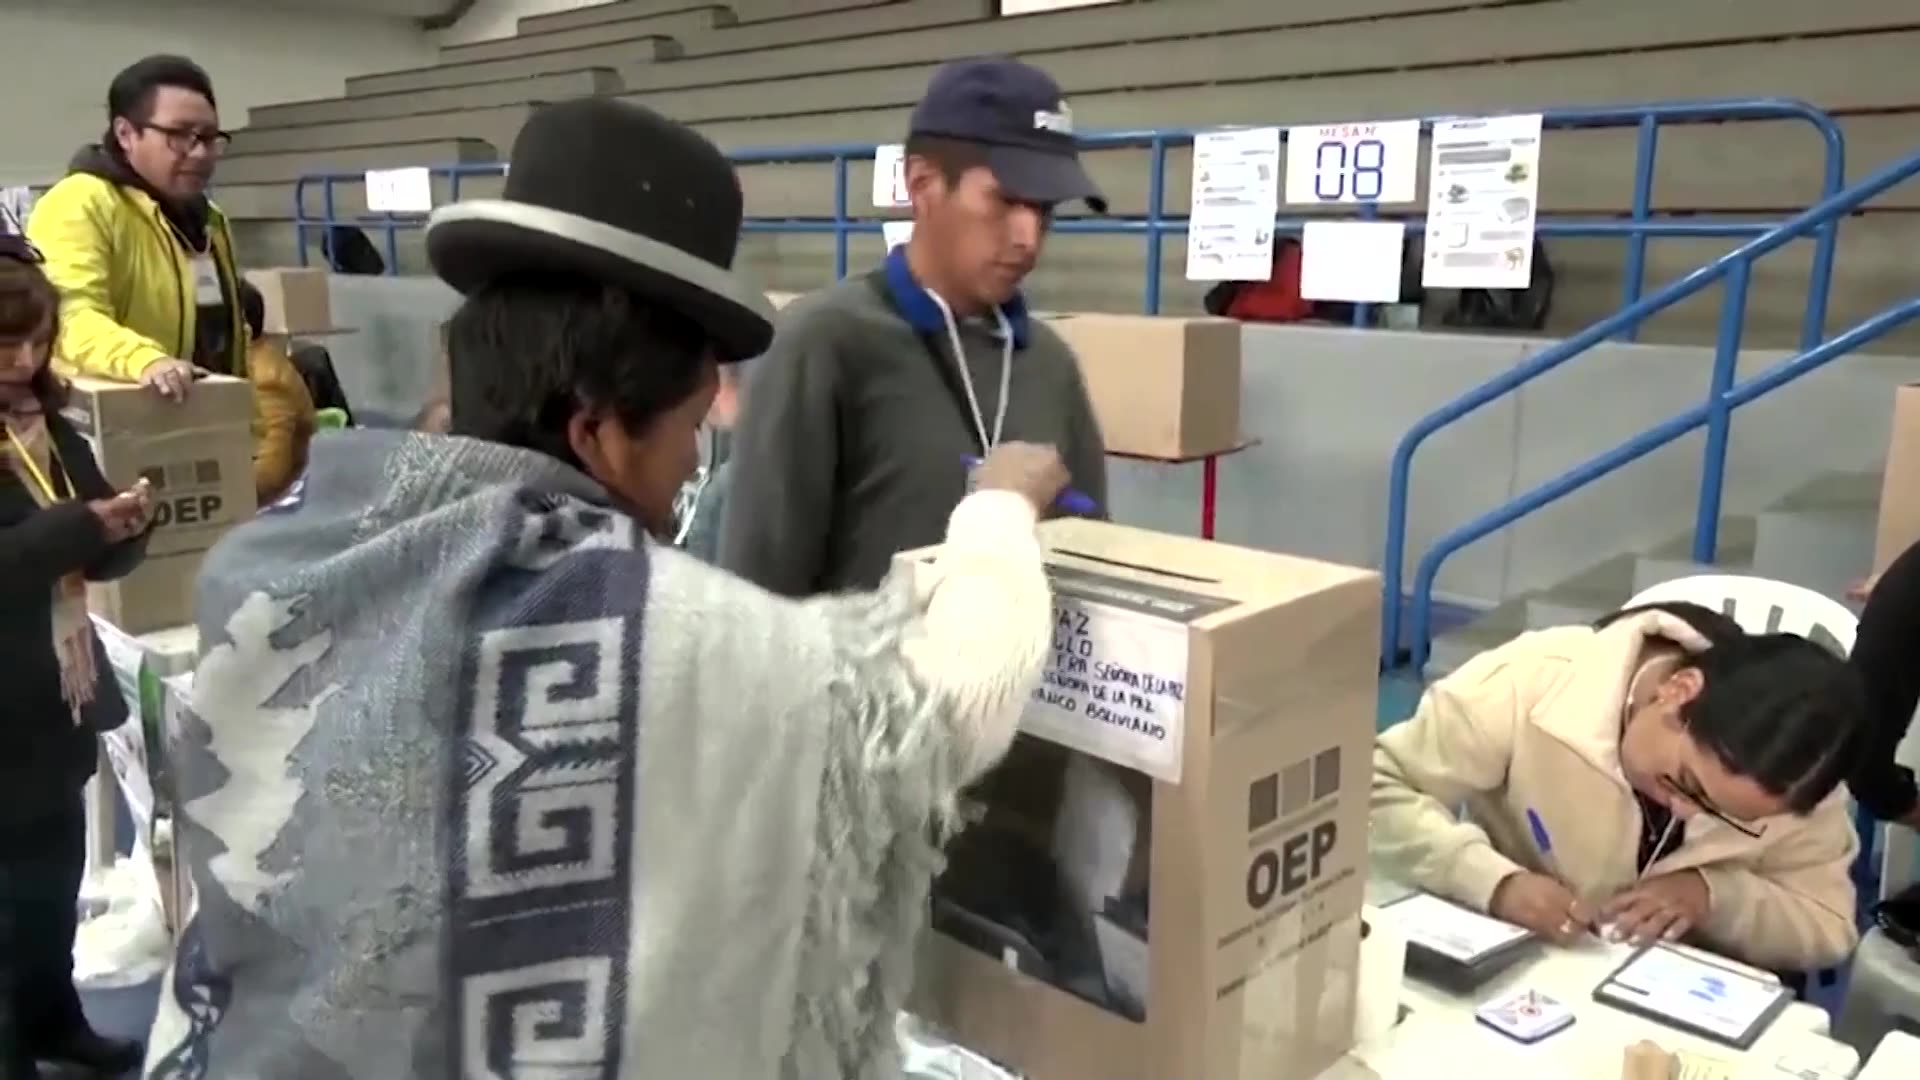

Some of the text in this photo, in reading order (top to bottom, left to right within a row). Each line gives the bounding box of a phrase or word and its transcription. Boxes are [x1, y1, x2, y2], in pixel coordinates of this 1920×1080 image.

[1314, 139, 1386, 201] 08
[1055, 608, 1089, 636] AZ
[1085, 702, 1166, 741] BOLIVIANO
[1246, 820, 1338, 910] OEP
